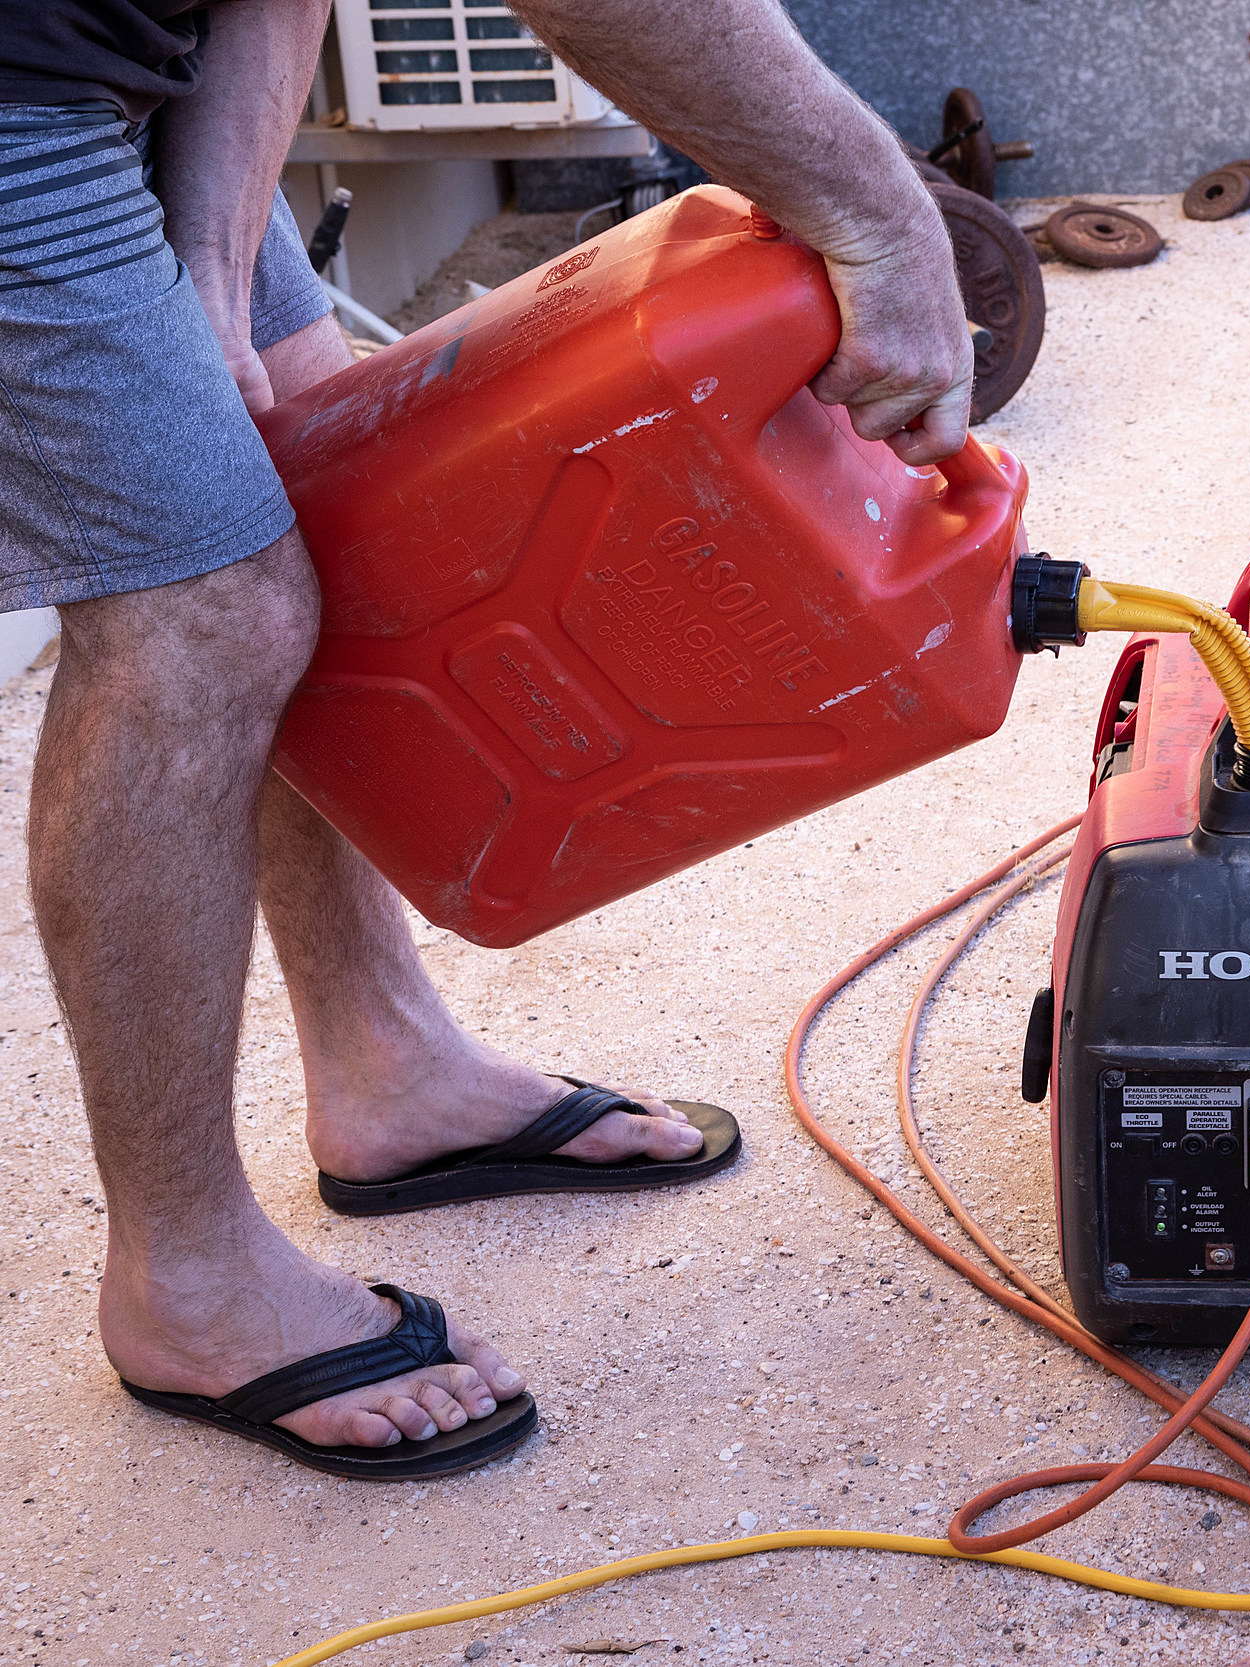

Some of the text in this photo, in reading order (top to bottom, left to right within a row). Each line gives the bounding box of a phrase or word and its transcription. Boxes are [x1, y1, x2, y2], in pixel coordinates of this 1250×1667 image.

[598, 566, 736, 711] EXTREMELY FLAMMABLE
[599, 594, 690, 691] KEEP OUT OF REACH
[621, 559, 753, 691] DANGER
[653, 516, 829, 690] GASOLINE
[495, 652, 566, 723] PETROLEUM
[598, 625, 663, 691] OF CHILDREN
[489, 676, 562, 750] FLAMMABLE
